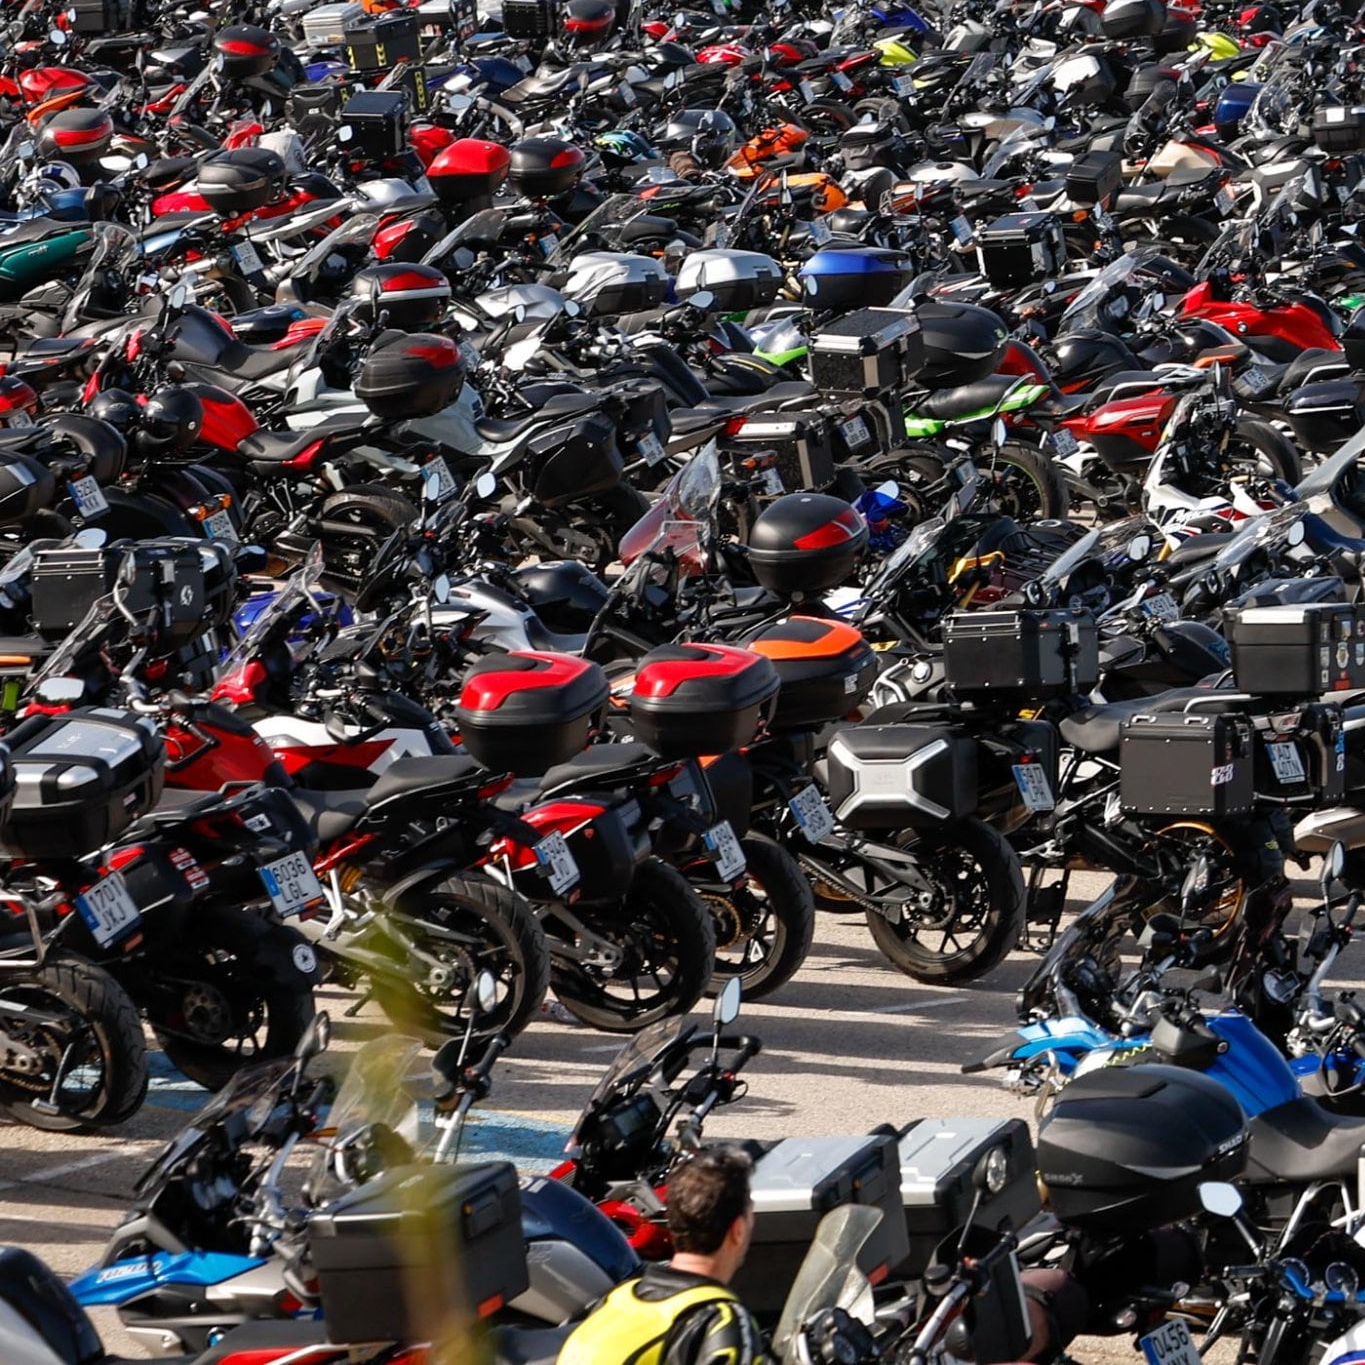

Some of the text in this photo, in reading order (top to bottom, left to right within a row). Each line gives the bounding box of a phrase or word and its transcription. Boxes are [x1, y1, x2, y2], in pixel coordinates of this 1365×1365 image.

[272, 856, 306, 885] 6036
[89, 878, 123, 912] 1701
[284, 878, 309, 904] LGL
[101, 900, 127, 932] JXJ
[1152, 1322, 1189, 1360] 0456
